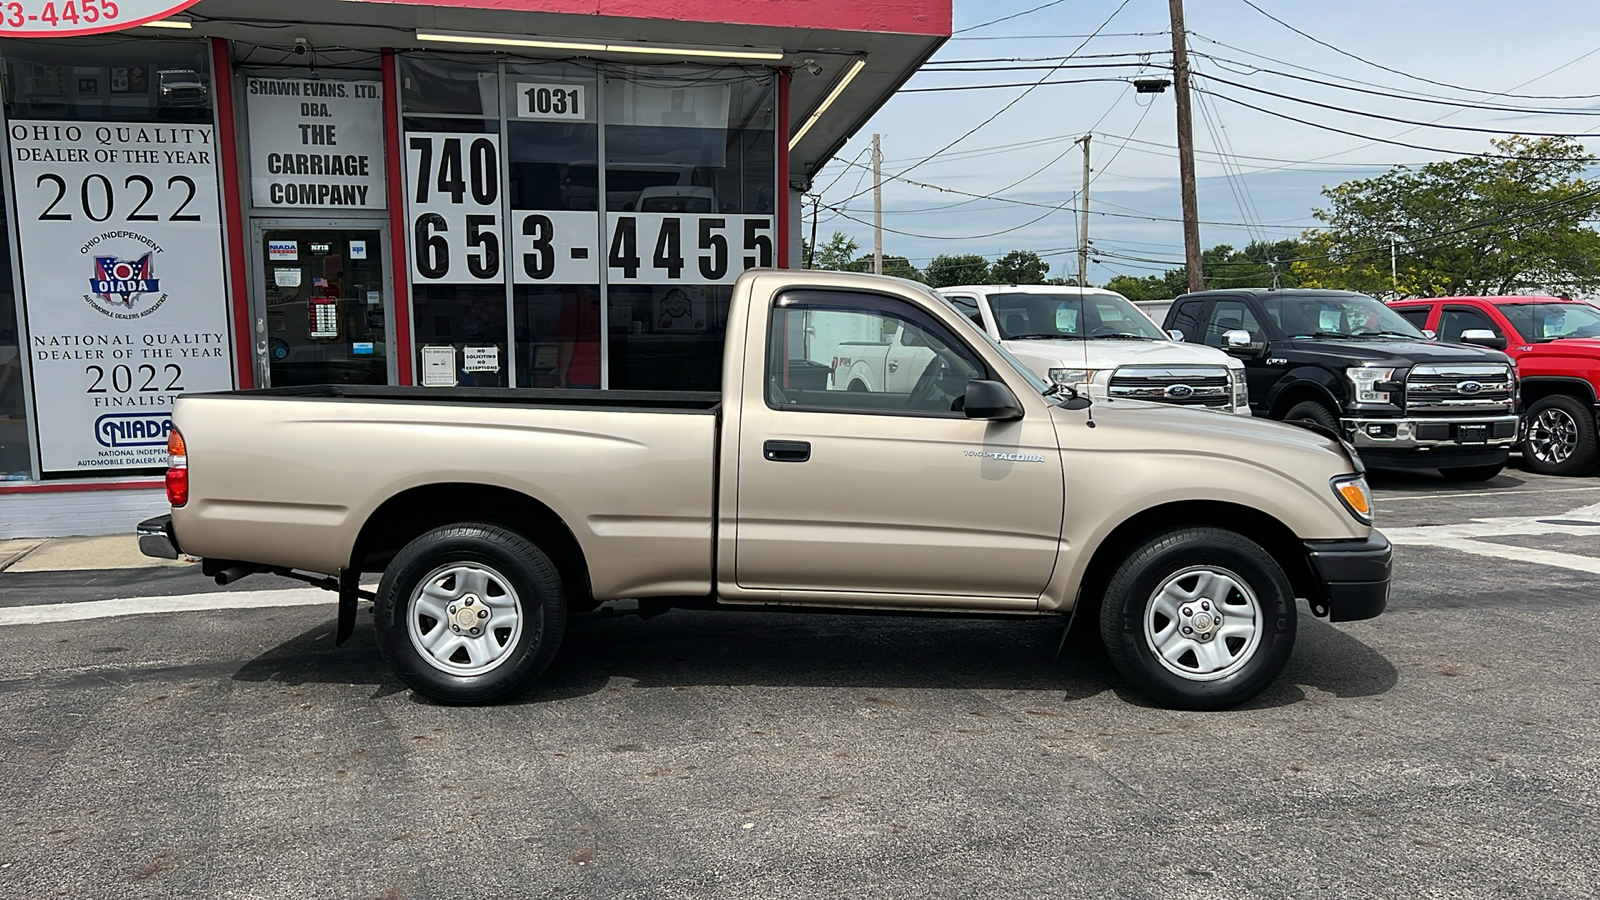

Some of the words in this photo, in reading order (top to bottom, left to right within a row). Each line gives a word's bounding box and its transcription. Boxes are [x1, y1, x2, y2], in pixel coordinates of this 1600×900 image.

[250, 80, 300, 96] SHAWN
[354, 84, 380, 98] LTD.
[300, 103, 332, 117] DBA.
[524, 88, 578, 114] 1031
[12, 124, 82, 141] OHIO
[96, 126, 212, 146] QUALITY
[298, 124, 336, 146] THE
[16, 148, 90, 162] DEALER
[94, 149, 118, 163] OF
[123, 150, 160, 164] THE
[163, 151, 210, 165] YEAR
[268, 153, 369, 176] CARRIAGE
[409, 137, 498, 206] 740
[36, 173, 201, 222] 2022
[270, 182, 368, 206] COMPANY
[80, 236, 100, 254] OHIO
[101, 231, 164, 254] INDEPENDENT
[99, 280, 148, 292] OIADA
[83, 294, 114, 318] AUTOMOBILE
[140, 292, 168, 317] ASSOCIATION
[34, 334, 134, 346] NATIONAL
[142, 334, 224, 346] QUALITY
[38, 350, 105, 360] DEALER
[112, 350, 134, 360] OF
[141, 348, 174, 359] THE
[181, 348, 223, 358] YEAR
[85, 363, 185, 394] 2022
[95, 395, 177, 407] FINALIST
[102, 419, 173, 447] NIADA
[990, 453, 1045, 463] TACOMA
